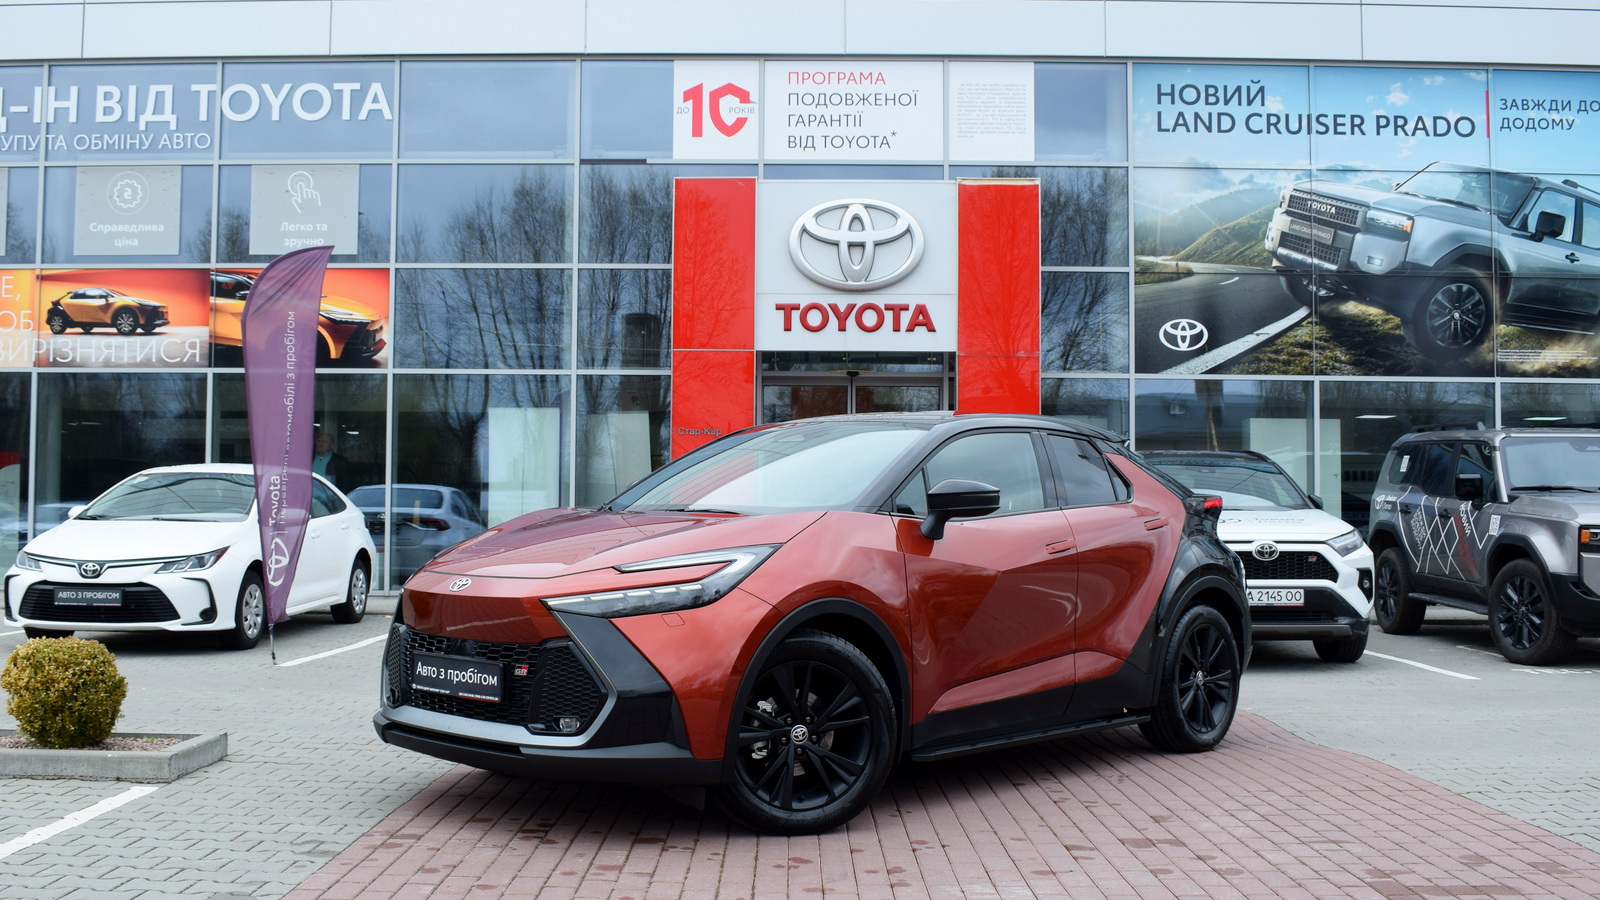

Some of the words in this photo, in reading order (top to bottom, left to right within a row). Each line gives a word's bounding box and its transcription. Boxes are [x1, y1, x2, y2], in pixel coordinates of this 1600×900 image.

[788, 71, 886, 85] ПРОГРАМА
[788, 90, 919, 108] ПОДОВЖЕНОЇ
[1156, 79, 1266, 108] НОВИЙ
[0, 86, 78, 132] -ІН
[95, 84, 177, 130] ВІД
[191, 82, 393, 122] TOYOTA
[676, 107, 690, 115] ДО
[729, 106, 755, 114] РОКІВ
[1499, 98, 1572, 114] ЗАВЖДИ
[788, 111, 863, 127] ГАРАНТІЇ
[1156, 111, 1236, 134] LAND
[1244, 112, 1367, 137] CRUISER
[1375, 114, 1476, 139] PRADO
[1499, 117, 1576, 132] ДОДОМУ
[46, 134, 68, 150] ТА
[73, 133, 154, 150] ОБМІНУ
[158, 132, 211, 150] АВТО
[788, 136, 816, 152] ВІД
[1307, 201, 1336, 214] TOYOTA
[89, 221, 164, 235] Справедлива
[280, 222, 312, 232] Легко
[315, 223, 328, 232] та
[114, 236, 139, 248] ціна
[283, 236, 324, 249] зручно
[775, 302, 936, 332] TOYOTA
[284, 311, 297, 369] пробігом
[677, 426, 722, 436] Стар-Кар
[58, 591, 76, 599] АВТО
[83, 591, 120, 599] ПРОБІГОМ
[1257, 591, 1282, 601] 2145
[416, 661, 437, 678] Авто
[439, 668, 445, 679] з
[447, 667, 498, 687] пробігом
